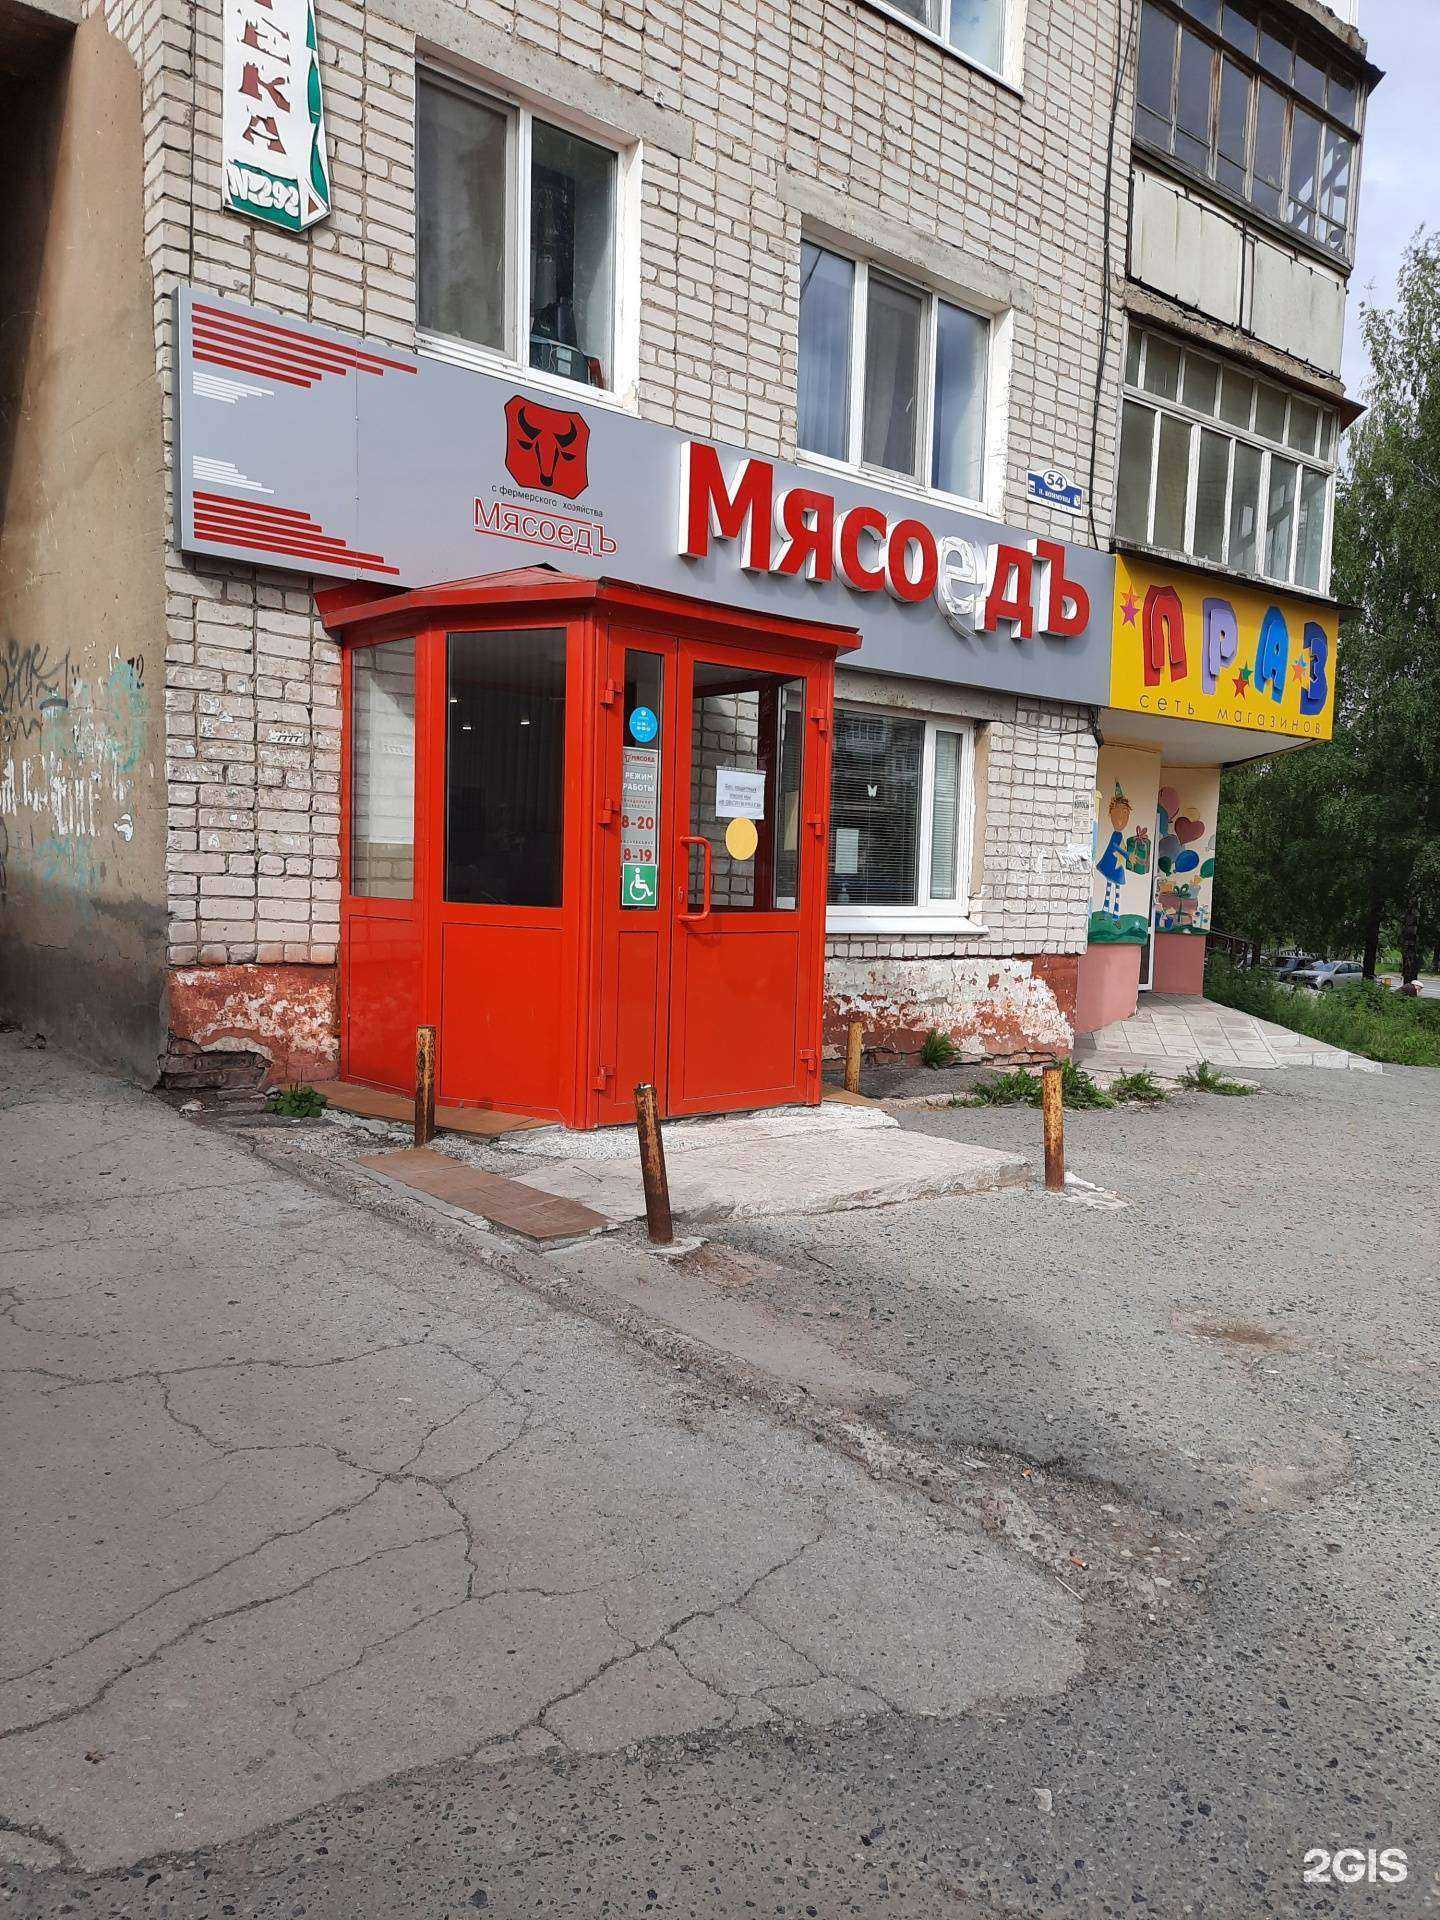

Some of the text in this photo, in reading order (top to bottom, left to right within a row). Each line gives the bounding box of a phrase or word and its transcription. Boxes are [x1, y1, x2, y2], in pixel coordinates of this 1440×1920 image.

[1046, 473, 1064, 489] 54
[499, 485, 558, 507] фермерского
[562, 501, 604, 518] хозяйства
[1217, 707, 1322, 735] магазинов
[625, 771, 653, 781] РЕЖИМ
[622, 783, 656, 793] РАБОТЫ
[622, 814, 654, 830] 8-20
[623, 847, 653, 862] 8-19
